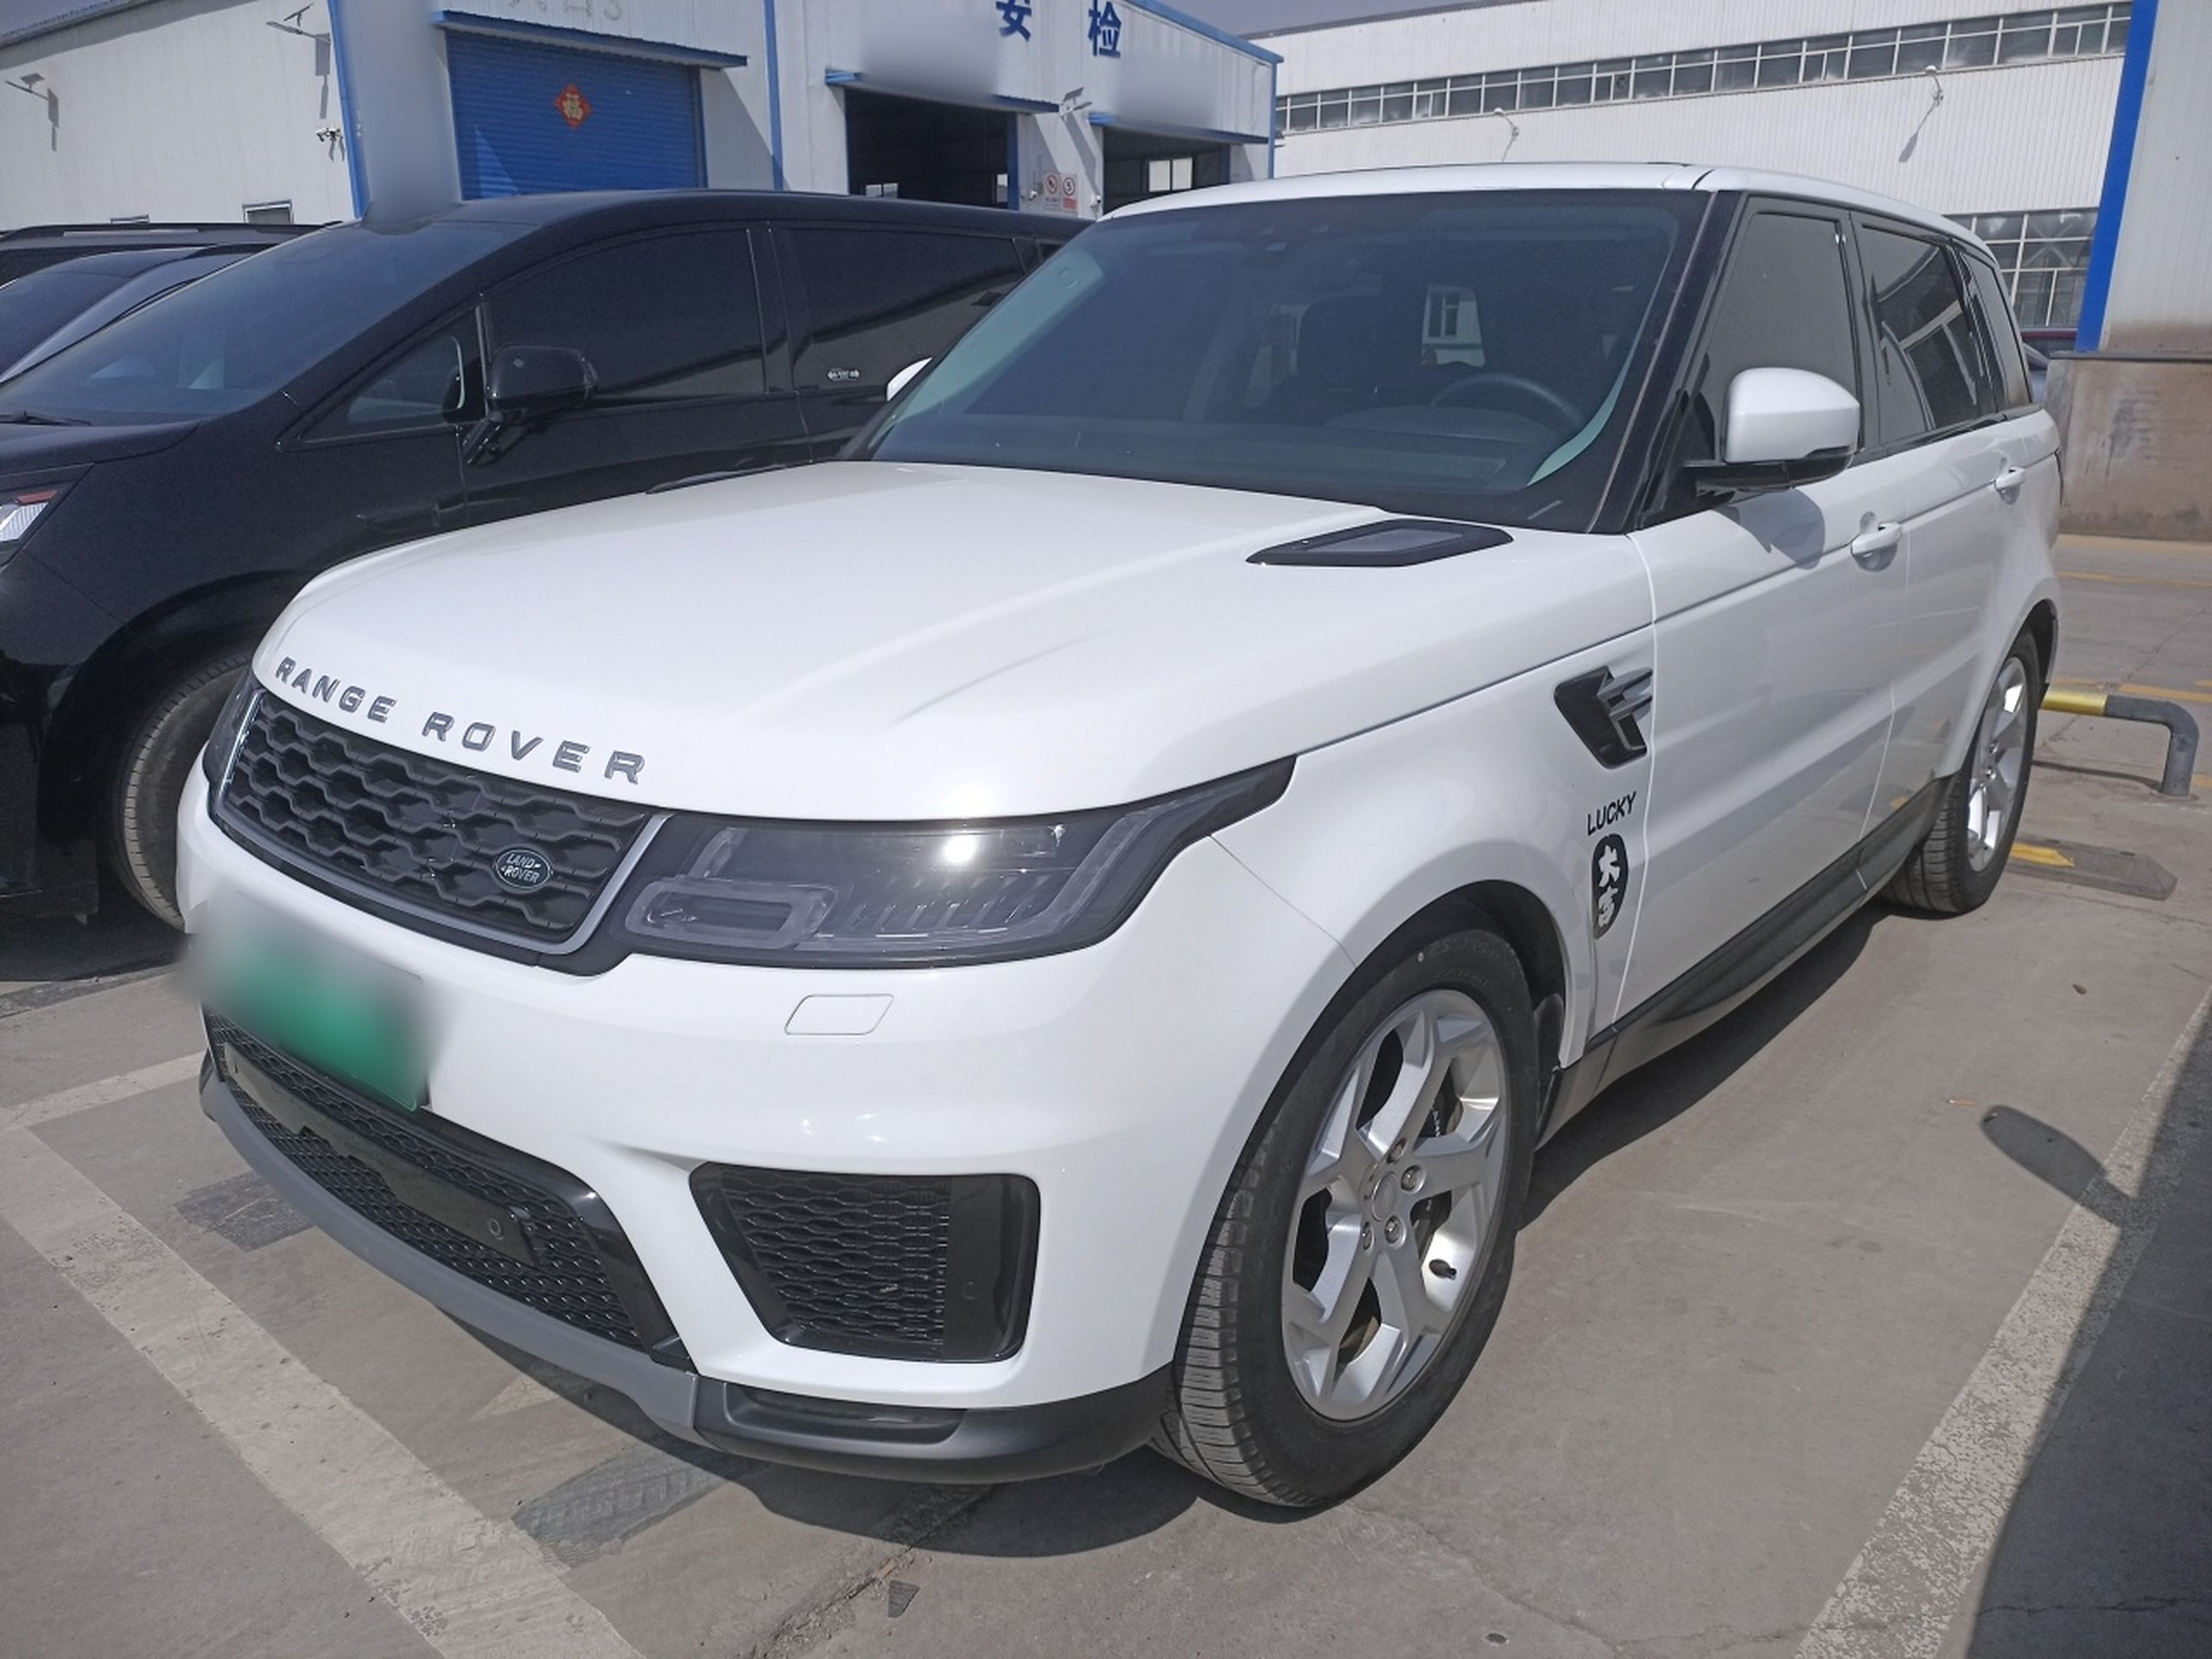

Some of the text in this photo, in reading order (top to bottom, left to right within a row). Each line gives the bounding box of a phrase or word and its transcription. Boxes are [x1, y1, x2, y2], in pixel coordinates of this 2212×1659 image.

[275, 657, 646, 785] RANGE ROVER
[1587, 791, 1637, 836] LUCKY
